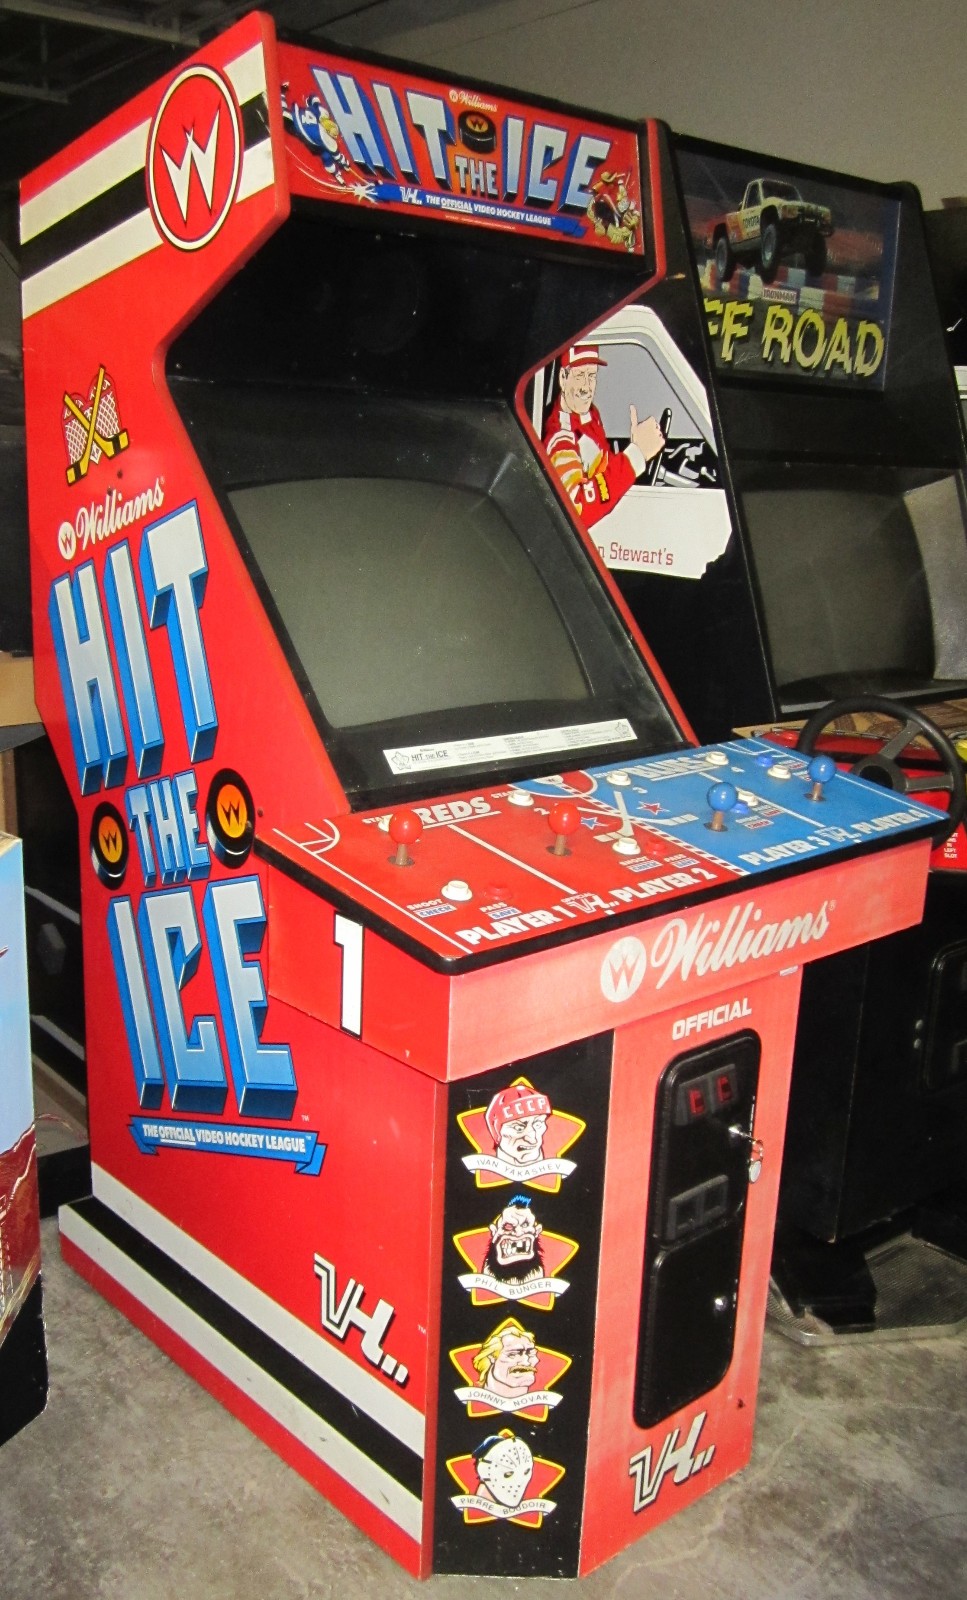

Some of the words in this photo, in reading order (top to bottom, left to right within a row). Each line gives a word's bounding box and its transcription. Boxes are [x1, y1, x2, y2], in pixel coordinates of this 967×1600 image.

[459, 91, 498, 112] Williams
[309, 64, 456, 191] HIT
[454, 155, 498, 198] THE
[501, 115, 613, 212] ICE
[425, 194, 441, 205] THE
[441, 198, 473, 213] OFFICIAL
[474, 203, 496, 216] VIDEO
[496, 208, 525, 221] HOCKEY
[525, 214, 552, 226] LEAGUE
[762, 304, 884, 377] ROAD
[76, 478, 165, 551] Williams
[610, 542, 674, 567] Stewart's
[48, 499, 218, 796] HIT
[411, 752, 424, 762] HIT
[435, 750, 449, 759] ICE
[411, 797, 491, 825] REDS
[125, 769, 211, 887] THE
[619, 856, 649, 866] SHOOT
[664, 854, 687, 862] PASS
[455, 910, 562, 945] PLAYER
[551, 905, 577, 918] 1
[608, 872, 702, 903] PLAYER
[690, 867, 718, 880] 2
[738, 839, 818, 866] PLAYER
[807, 836, 830, 846] 3
[851, 811, 912, 835] PLAYER
[906, 808, 931, 820] 4
[406, 899, 442, 910] SHOOT
[419, 905, 453, 917] CHECK
[479, 902, 508, 912] PASS
[492, 907, 518, 919] SAVE
[651, 901, 829, 990] Williams
[334, 911, 364, 1039] 1
[107, 875, 298, 1120] ICE
[671, 998, 752, 1041] OFFICIAL
[142, 1123, 159, 1139] THE
[159, 1125, 196, 1145] OFFICIAL
[195, 1129, 224, 1145] VIDEO
[224, 1132, 264, 1149] HOCKEY
[265, 1136, 306, 1153] LEAGUE
[476, 1157, 499, 1169] IVAN
[503, 1163, 562, 1178] YAKASHEV
[474, 1276, 501, 1292] PHIL
[508, 1281, 553, 1297] BUNGER
[467, 1390, 506, 1407] JOHNNY
[513, 1394, 549, 1408] NOVAK
[460, 1497, 495, 1512] PIERRE
[502, 1502, 547, 1516] BOUDOIR
